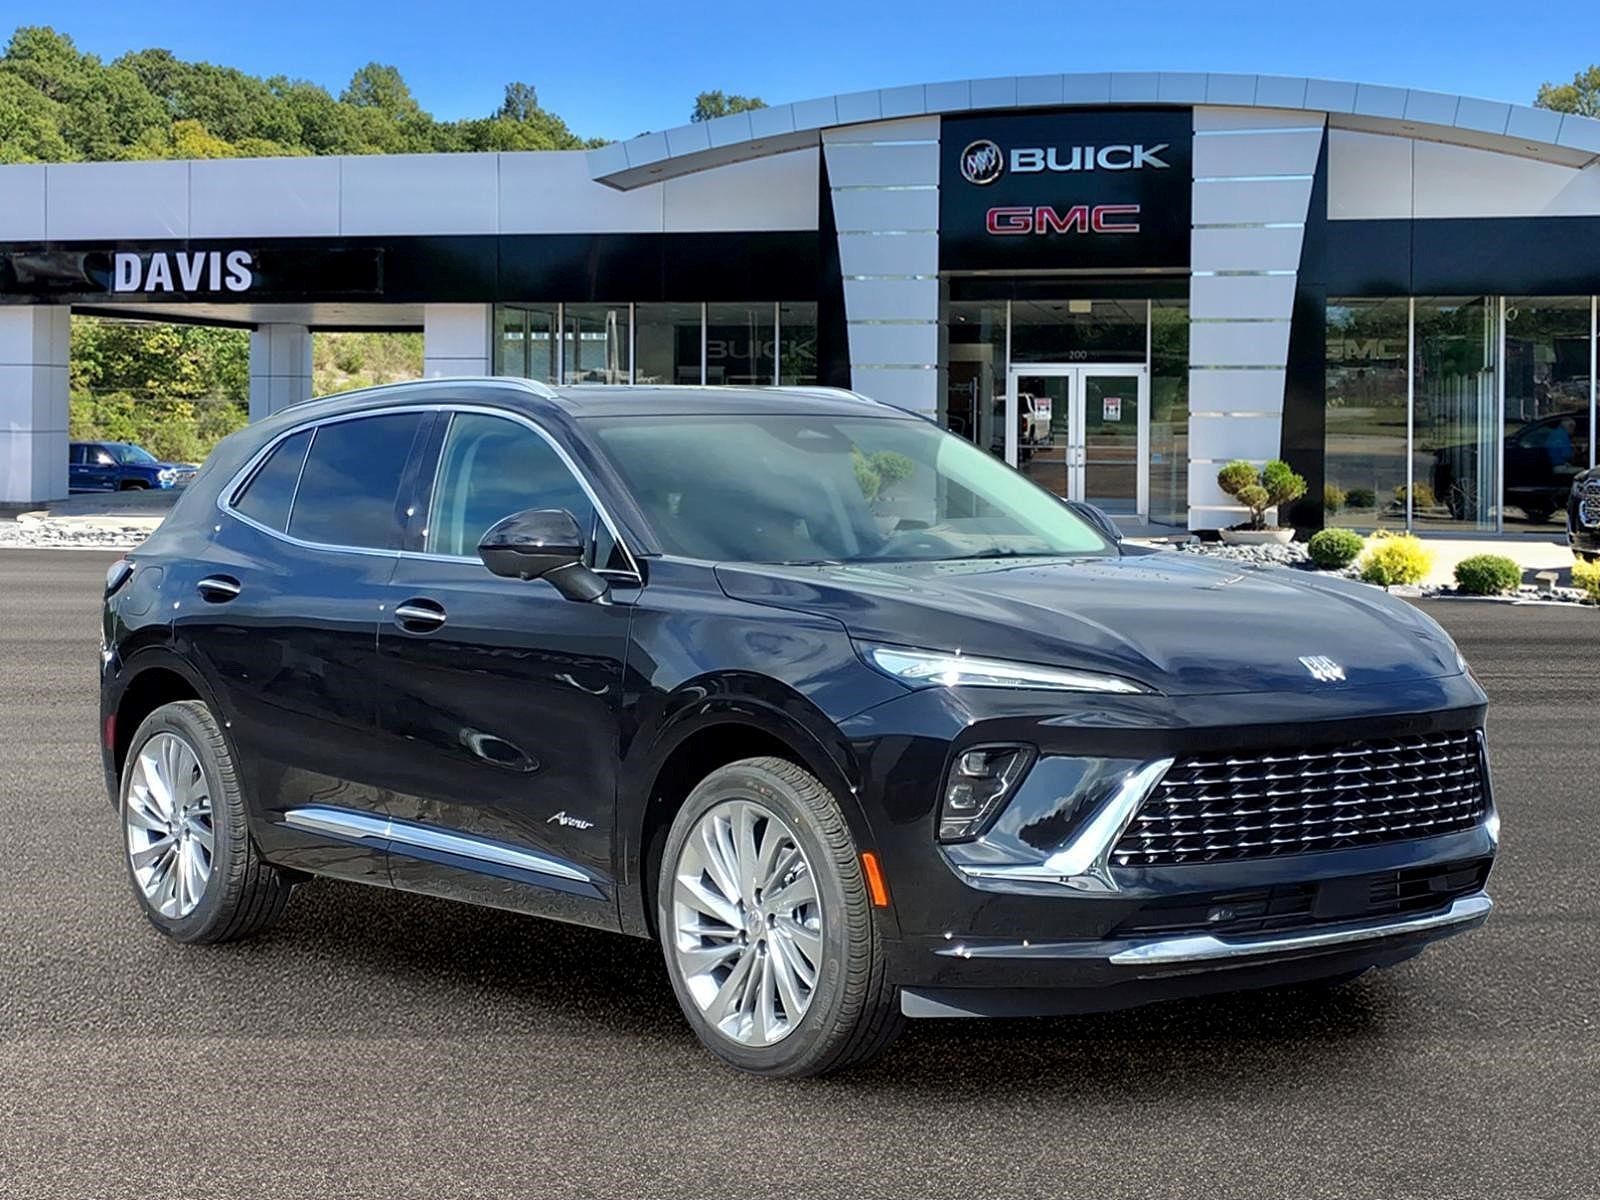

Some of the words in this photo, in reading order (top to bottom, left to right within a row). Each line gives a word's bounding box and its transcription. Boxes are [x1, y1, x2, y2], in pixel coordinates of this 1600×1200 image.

[1010, 143, 1170, 172] BUICK
[986, 204, 1141, 234] GMC
[114, 251, 253, 292] DAVIS
